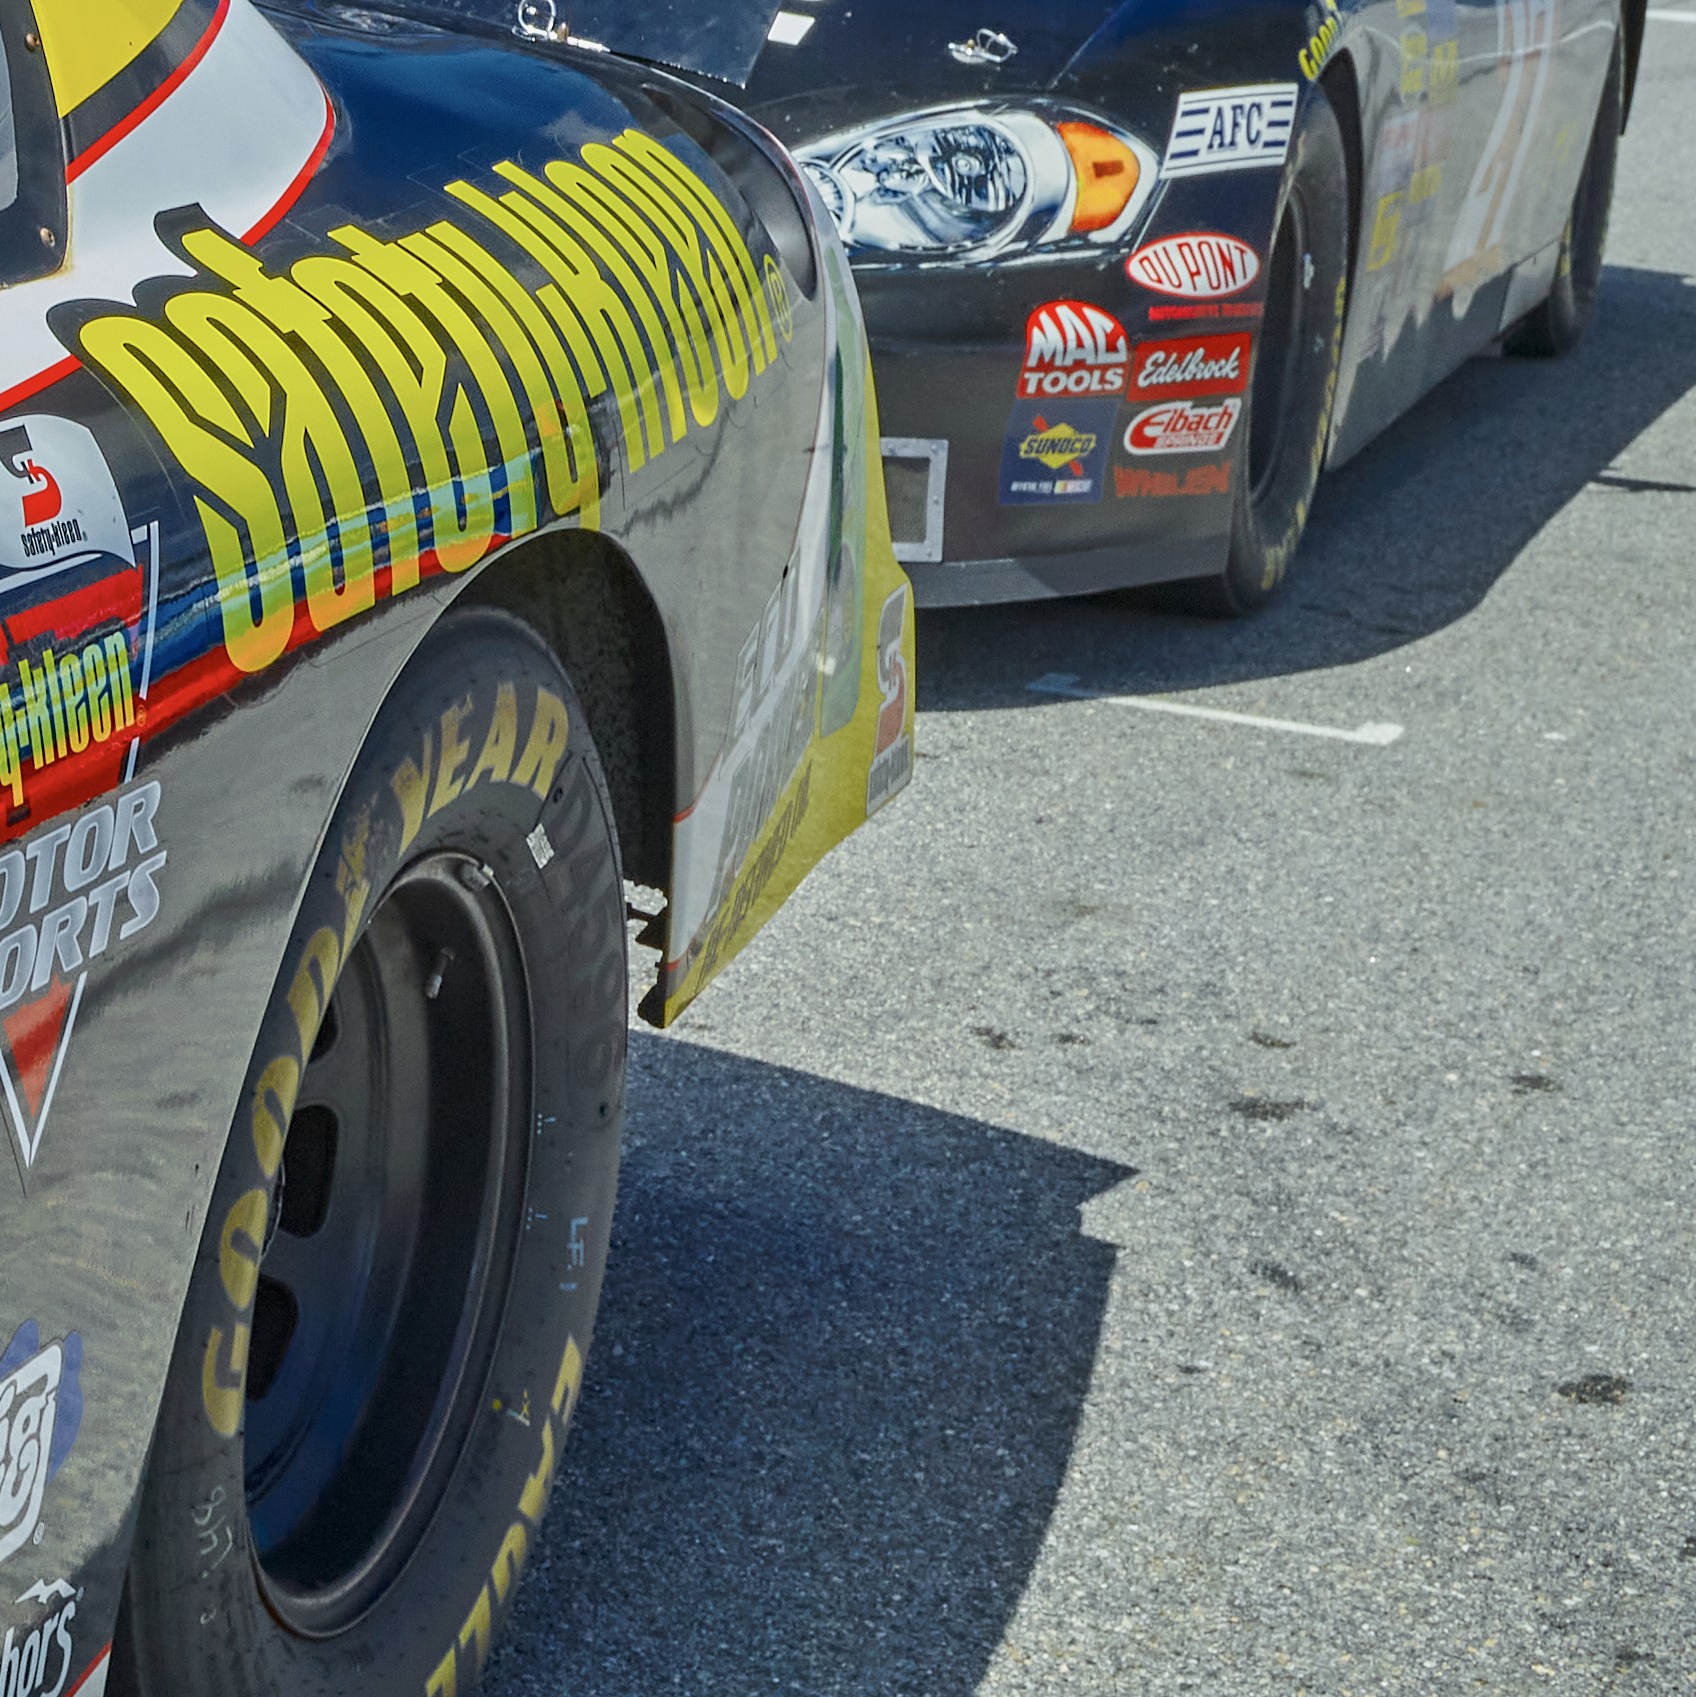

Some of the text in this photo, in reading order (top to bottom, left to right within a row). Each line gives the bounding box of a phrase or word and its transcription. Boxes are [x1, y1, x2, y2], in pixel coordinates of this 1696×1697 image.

[1207, 102, 1265, 153] AFC
[1186, 239, 1252, 296] PONT
[1027, 304, 1129, 368] MAC
[1023, 367, 1125, 394] TOOLS
[1136, 346, 1242, 388] Edelbrock
[1023, 436, 1096, 456] SUNOCO
[1128, 404, 1235, 450] Eibach
[20, 516, 85, 558] safety-kleen
